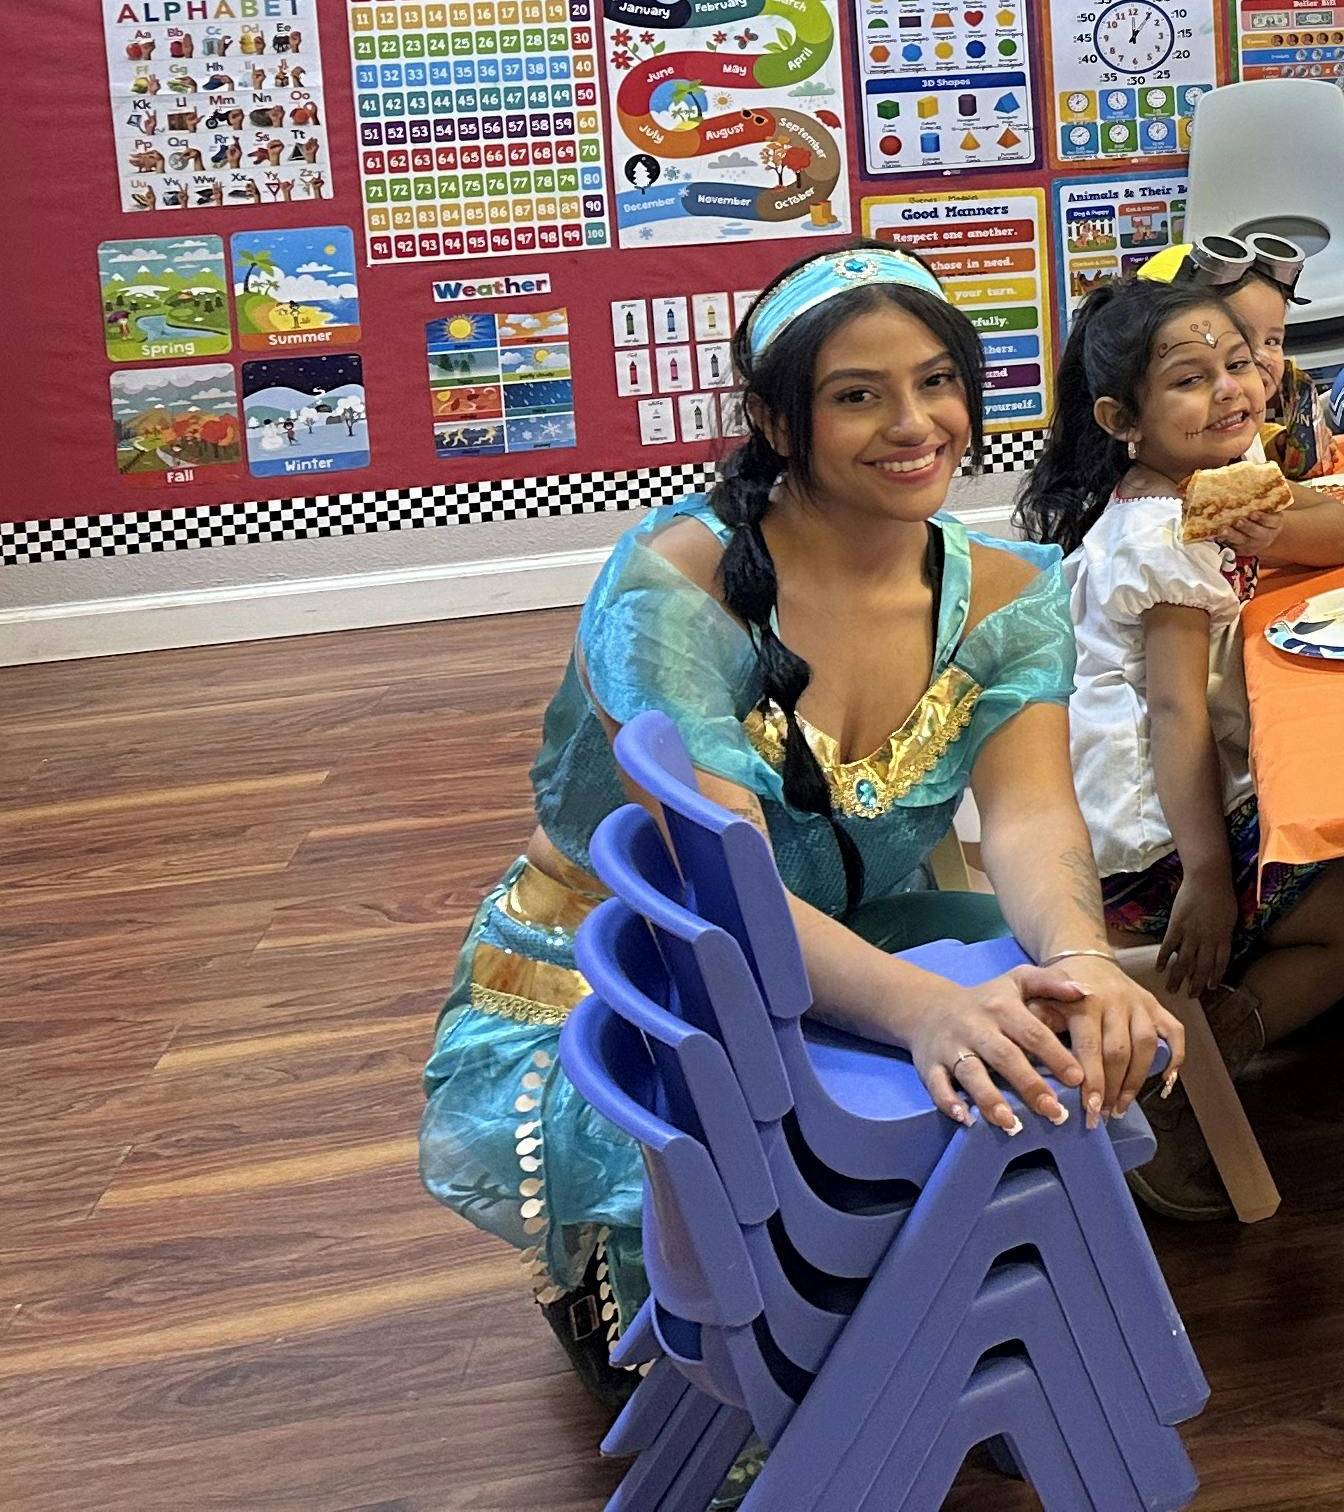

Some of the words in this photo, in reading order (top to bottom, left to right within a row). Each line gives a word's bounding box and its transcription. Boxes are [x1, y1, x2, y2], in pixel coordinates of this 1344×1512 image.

[356, 13, 369, 25] 11
[380, 12, 394, 24] 12
[404, 11, 418, 23] 13
[429, 10, 443, 22] 14
[453, 9, 468, 20] 15
[477, 8, 492, 20] 16
[502, 7, 515, 18] 17
[525, 6, 540, 18] 18
[548, 5, 563, 16] 19
[572, 4, 588, 16] 20
[618, 2, 670, 19] January
[358, 42, 372, 54] 21
[382, 41, 397, 52] 22
[406, 40, 421, 52] 23
[430, 39, 446, 50] 24
[454, 38, 470, 49] 25
[478, 37, 494, 48] 26
[502, 36, 518, 47] 27
[526, 34, 542, 46] 28
[550, 34, 565, 45] 29
[574, 32, 590, 44] 30
[206, 62, 223, 72] Hh
[788, 48, 813, 71] April
[646, 66, 675, 83] June
[722, 64, 747, 76] May
[937, 78, 970, 87] Shapes
[133, 100, 150, 110] Kk
[209, 96, 235, 106] Mm
[252, 93, 272, 103] Nn
[290, 91, 310, 100] Oo
[291, 129, 305, 139] Tt
[639, 125, 664, 144] July
[706, 122, 744, 141] August
[778, 117, 827, 159] September
[623, 196, 675, 213] December
[697, 194, 752, 207] November
[774, 186, 815, 210] October
[1068, 190, 1119, 202] Animals
[1124, 189, 1134, 198] &
[1139, 187, 1172, 197] Their
[902, 207, 939, 220] Good
[946, 206, 1009, 217] Manners
[893, 231, 938, 243] Respect
[967, 227, 1018, 237] another.
[932, 261, 961, 271] those
[967, 259, 980, 268] in
[984, 257, 1014, 267] need.
[434, 277, 548, 300] Weather
[954, 289, 982, 300] your
[268, 330, 332, 346] Summer
[141, 342, 195, 358] Spring
[984, 399, 1036, 414] yourself.
[285, 457, 334, 472] Winter
[167, 469, 194, 484] Fall
